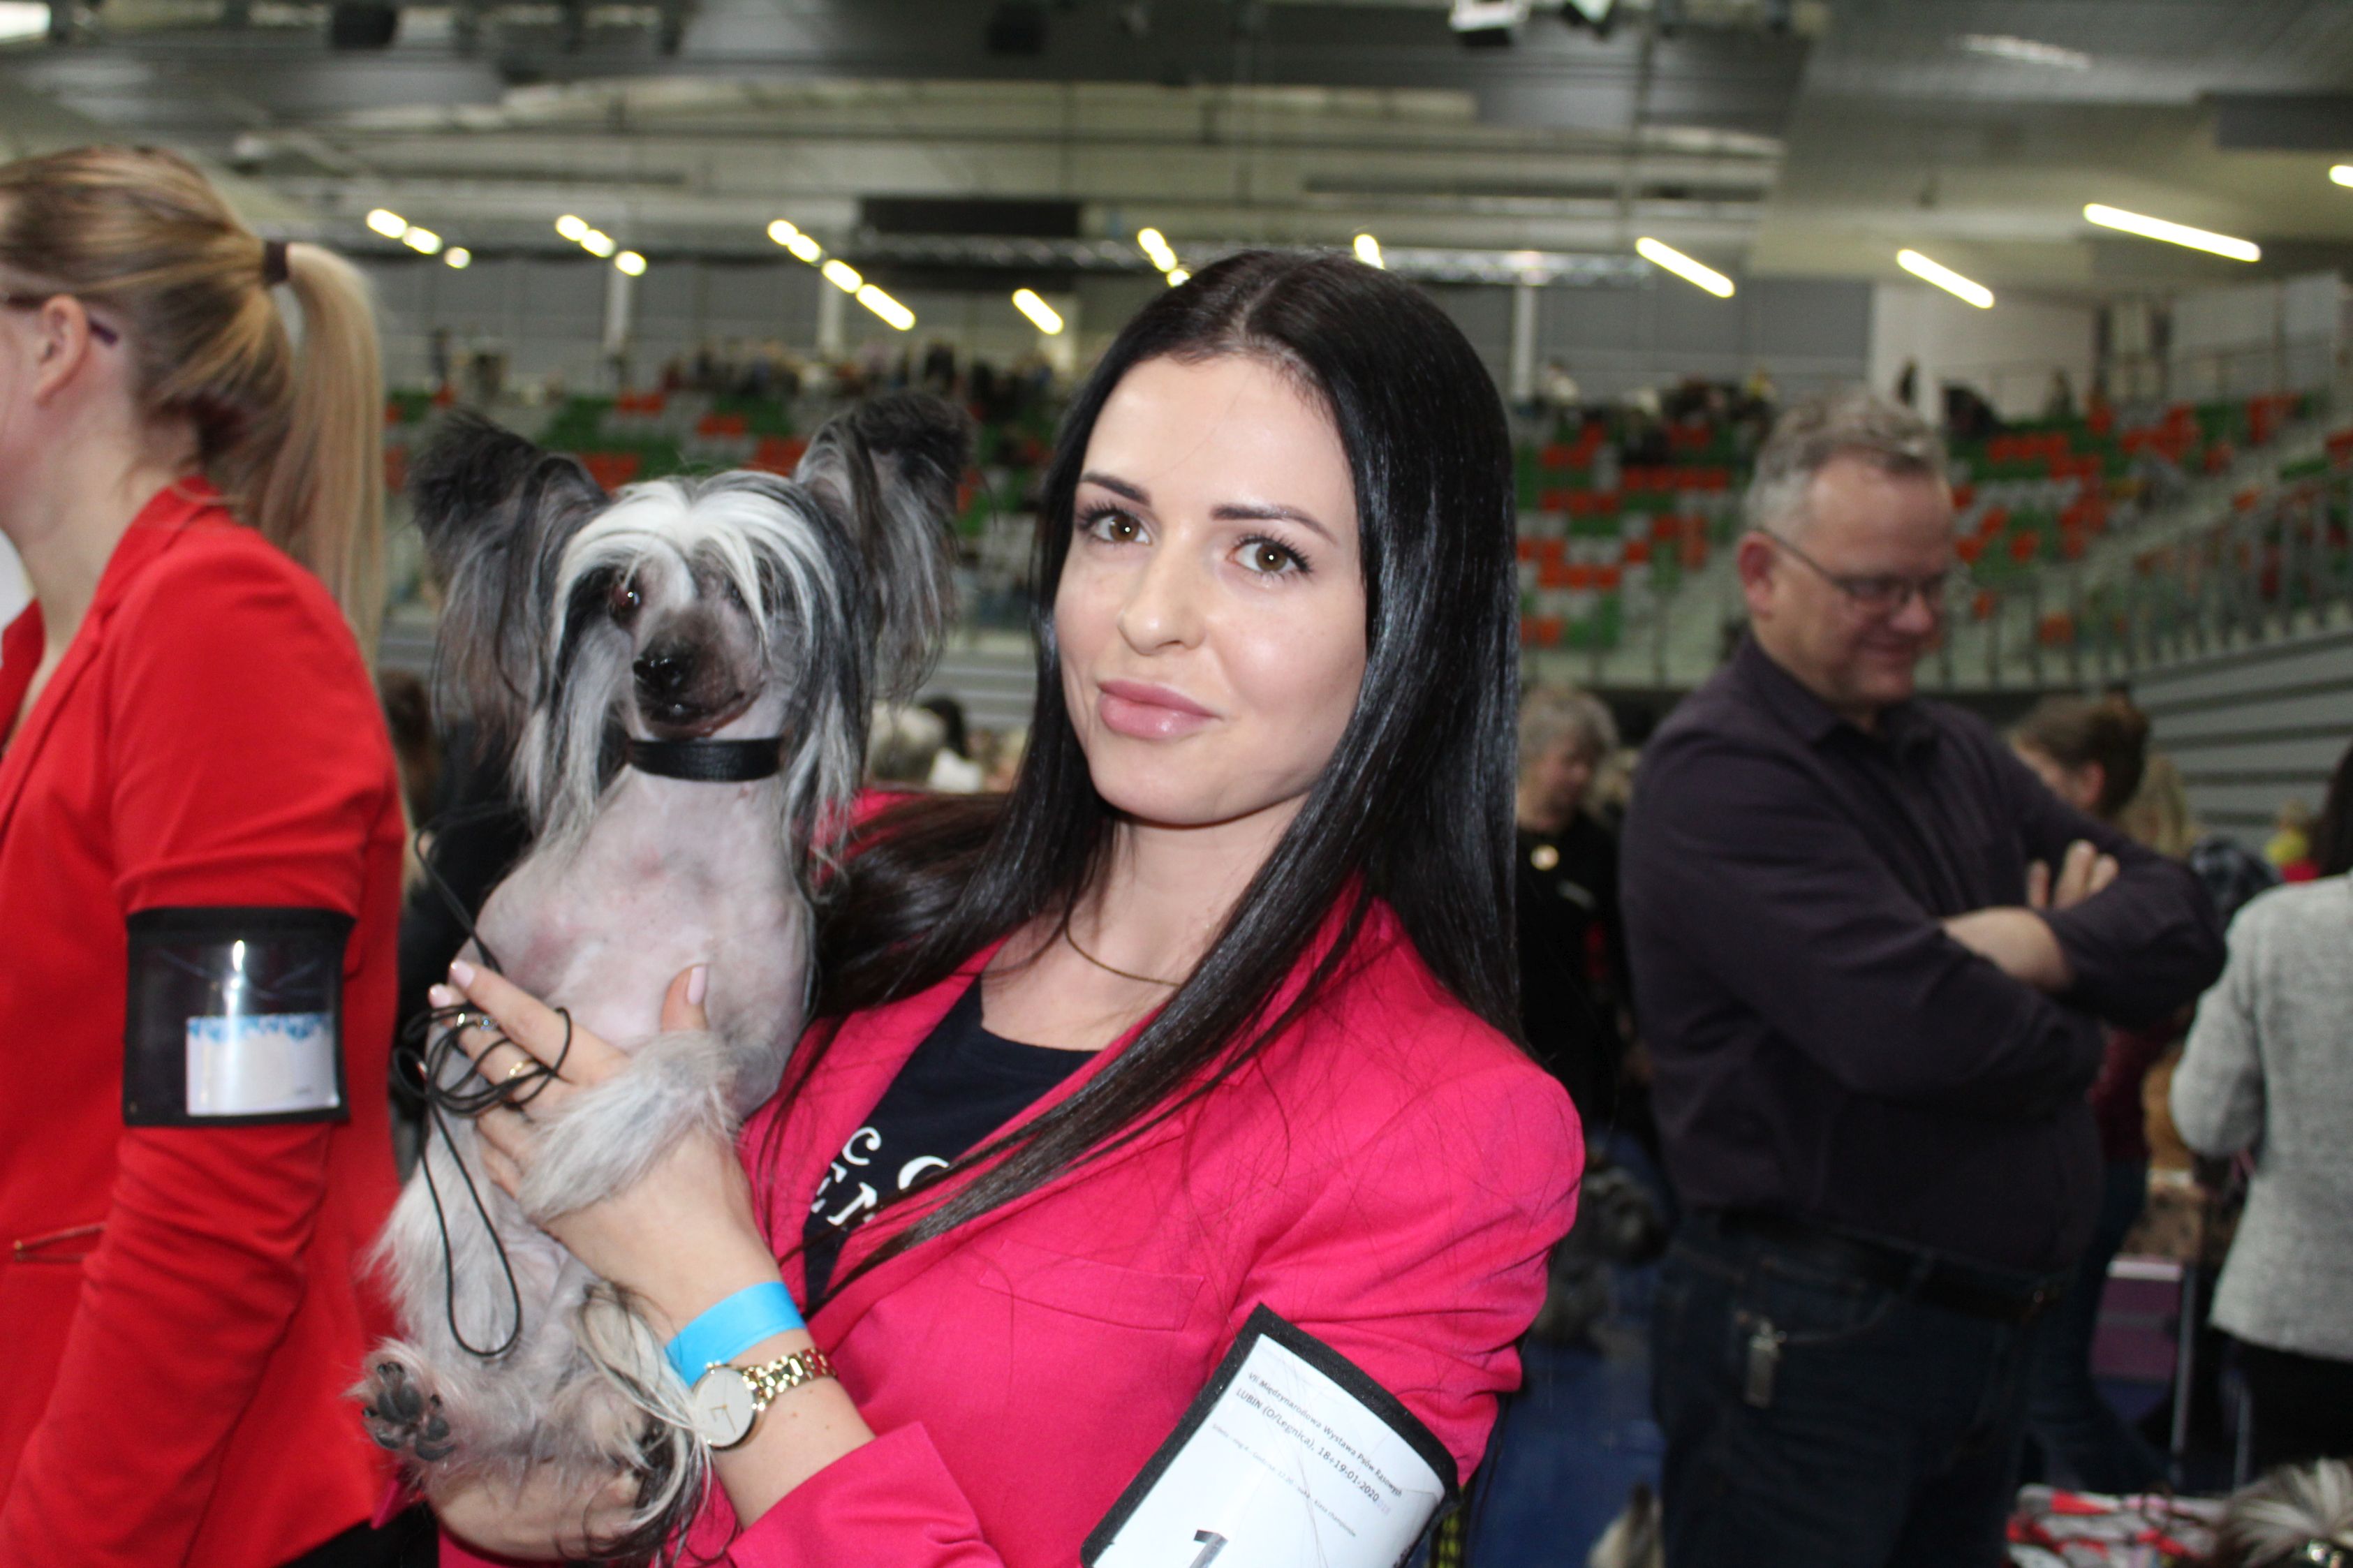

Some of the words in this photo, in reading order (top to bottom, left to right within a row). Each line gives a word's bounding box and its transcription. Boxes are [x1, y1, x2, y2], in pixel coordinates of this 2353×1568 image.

[1236, 1387, 1263, 1410] LUBIN
[1324, 1425, 1357, 1456] Wystawa
[1357, 1453, 1374, 1472] Psów
